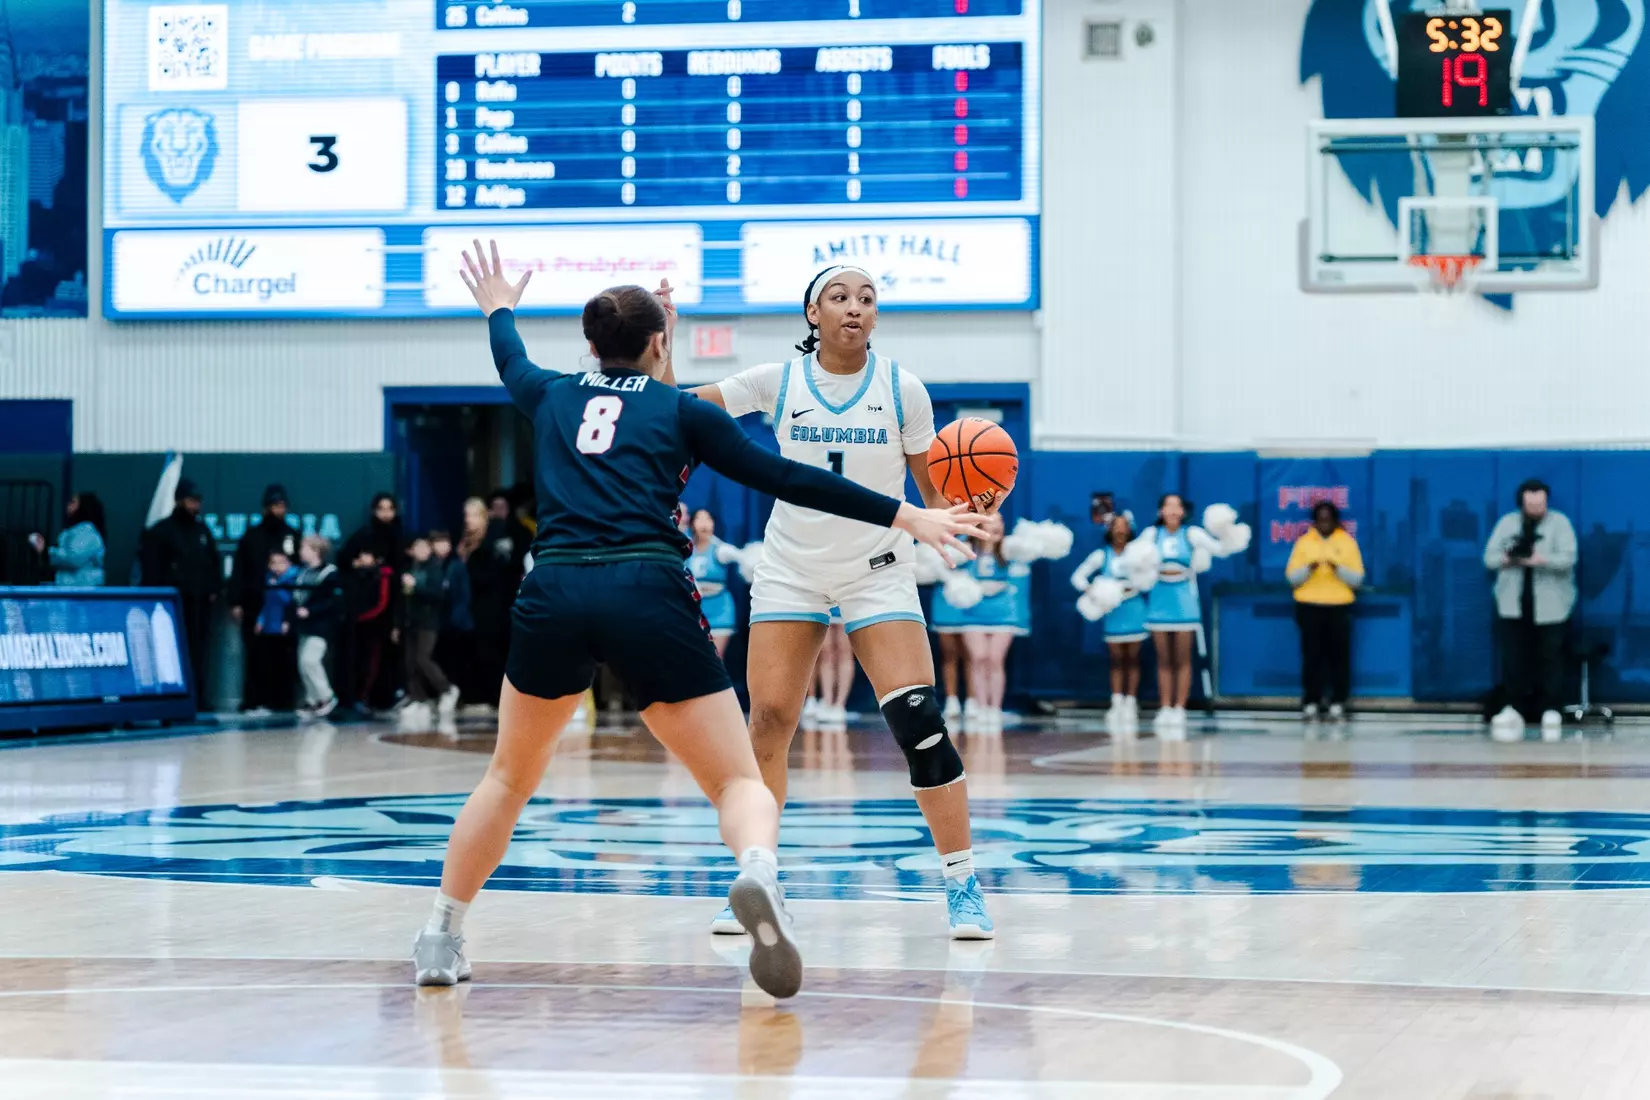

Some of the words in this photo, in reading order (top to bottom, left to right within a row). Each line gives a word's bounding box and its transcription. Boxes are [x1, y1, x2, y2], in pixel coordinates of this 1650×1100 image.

[1426, 17, 1502, 52] 5:32
[475, 53, 541, 77] PLAYER
[595, 52, 663, 77] POINTS
[687, 49, 781, 76] REBOUNDS
[815, 46, 893, 72] ASSISTS
[932, 44, 990, 70] FOULS
[622, 78, 636, 100] 0
[727, 75, 741, 97] 0
[847, 73, 861, 95] 0
[1441, 53, 1487, 107] 19
[445, 107, 458, 129] 1
[622, 104, 636, 126] 0
[727, 101, 741, 124] 0
[847, 99, 861, 121] 0
[622, 130, 636, 152] 0
[727, 128, 741, 150] 0
[847, 125, 861, 148] 0
[307, 135, 339, 173] 3
[622, 156, 636, 178] 0
[622, 182, 636, 205] 0
[727, 180, 741, 203] 0
[847, 178, 861, 201] 0
[812, 235, 890, 264] AMITY
[900, 235, 962, 264] HALL
[193, 272, 297, 300] Chargel
[579, 371, 649, 392] MILLER
[576, 395, 623, 454] 8
[790, 425, 888, 444] COLUMBIA
[826, 451, 845, 476] 1
